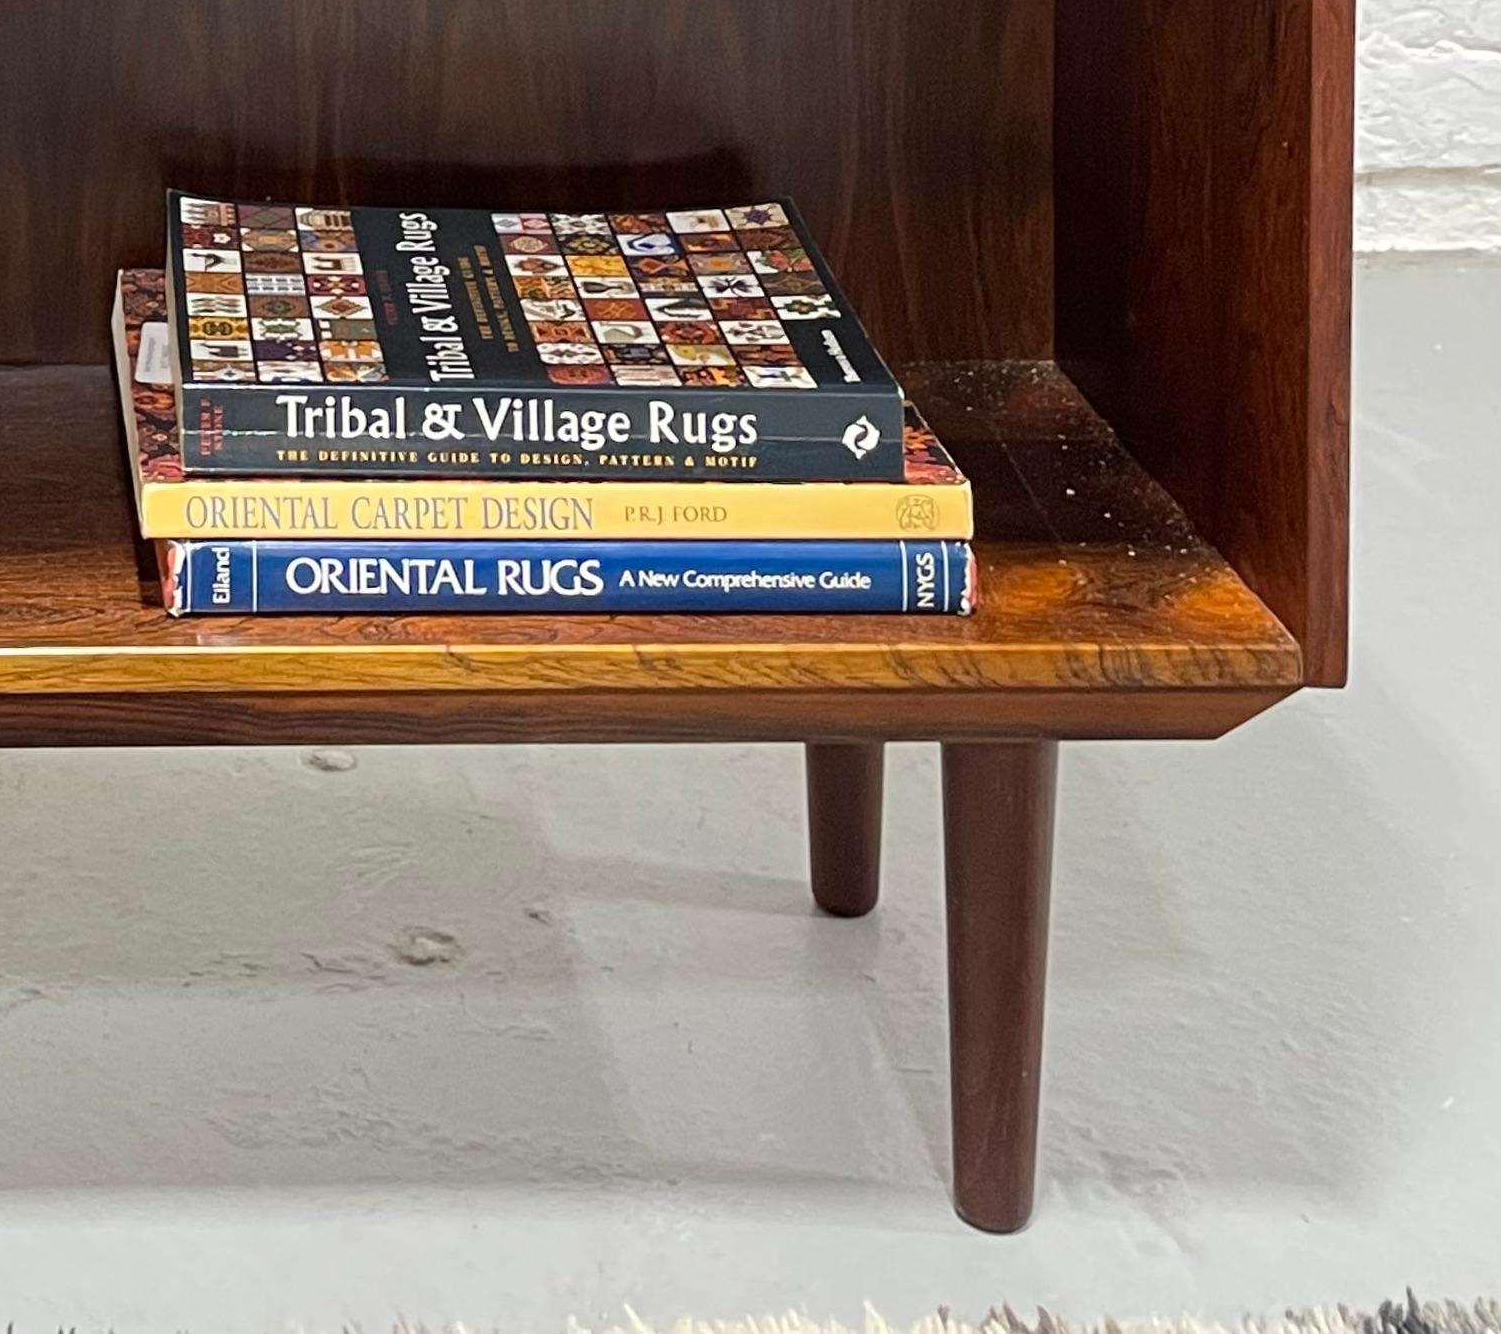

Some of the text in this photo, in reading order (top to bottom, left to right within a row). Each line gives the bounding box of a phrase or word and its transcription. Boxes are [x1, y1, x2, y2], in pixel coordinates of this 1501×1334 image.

[395, 212, 476, 383] Tribal & Village Rugs
[275, 394, 758, 453] Tribal & Village Rugs
[276, 449, 758, 468] THE DEFINITIVE GUIDE TO DESIGN, PATTERN & MOTIF
[185, 495, 594, 531] ORIENTAL CARPET DESIGN
[673, 505, 728, 523] FORD
[285, 557, 605, 597] ORIENTAL RUGS
[619, 568, 873, 593] A New Comprehensive Guide
[915, 551, 936, 608] NYGS
